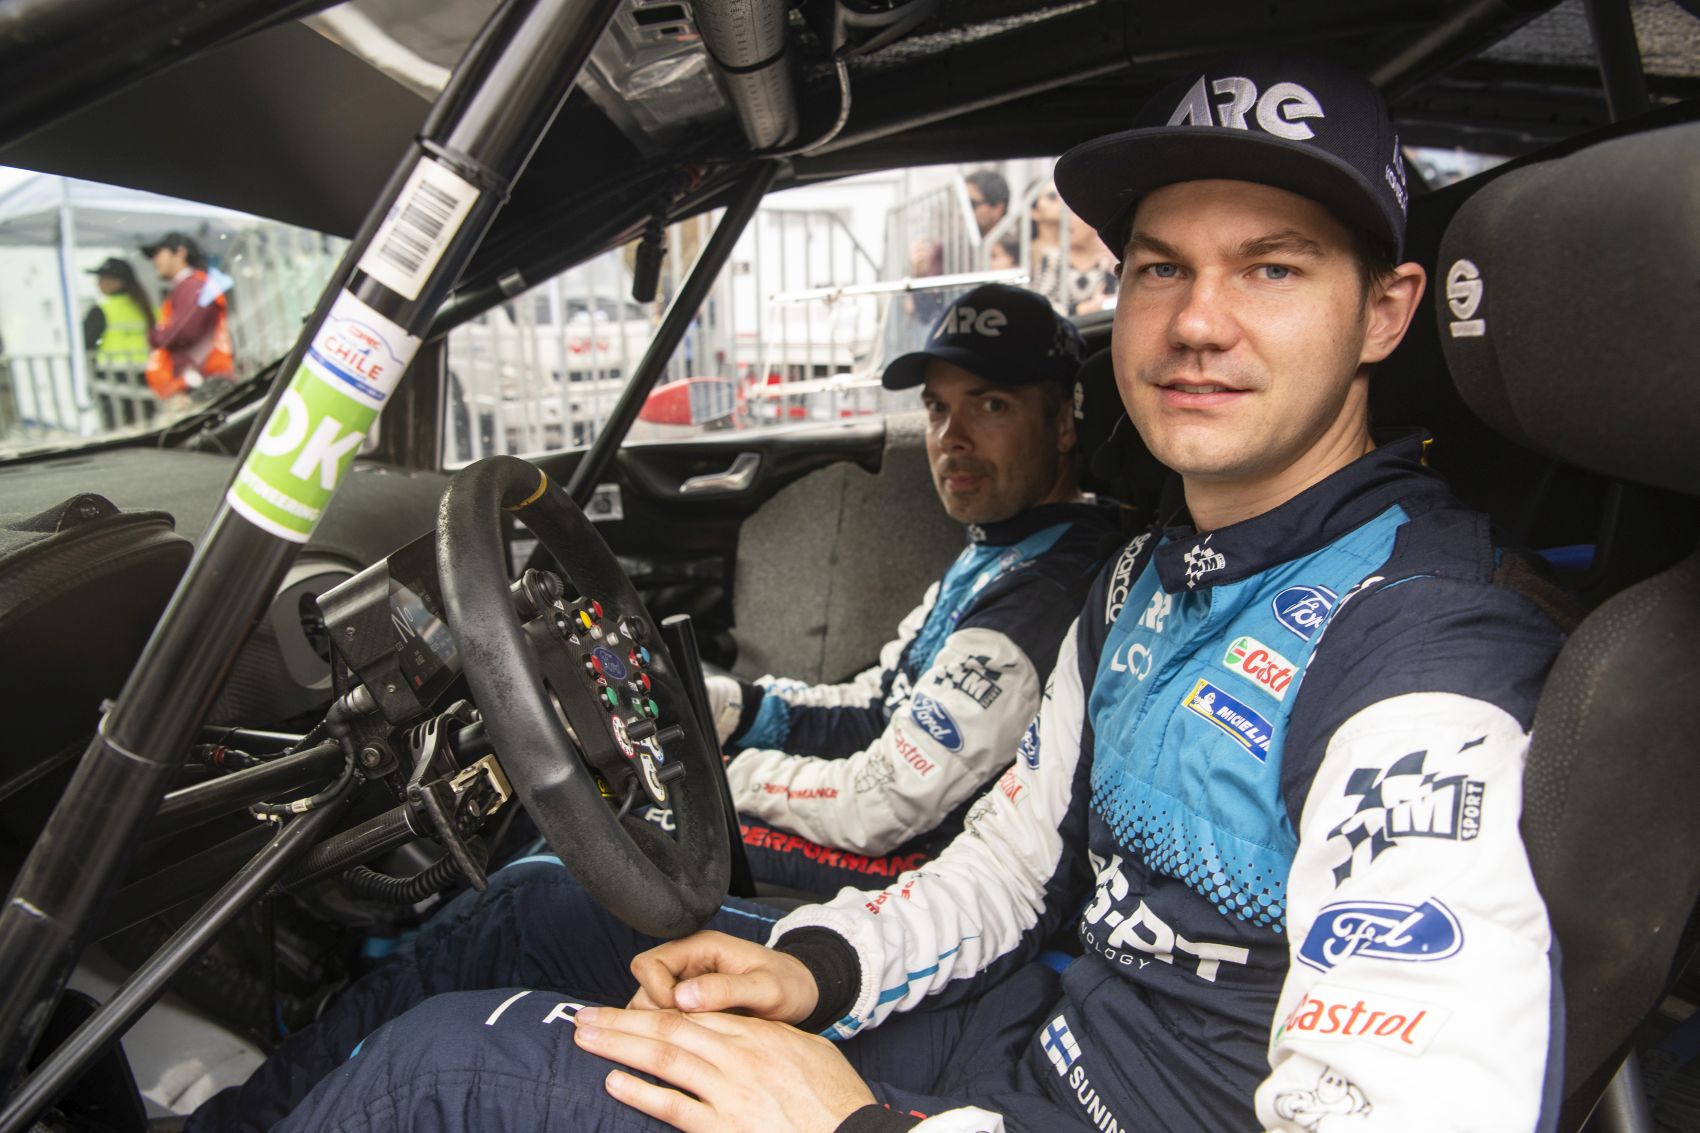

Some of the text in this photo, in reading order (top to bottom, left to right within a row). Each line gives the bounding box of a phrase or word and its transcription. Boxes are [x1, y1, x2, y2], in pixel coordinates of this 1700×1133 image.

[324, 336, 385, 381] CHILE
[255, 387, 366, 491] OK
[1461, 783, 1483, 840] SPORT
[1081, 921, 1151, 971] NOLOGY
